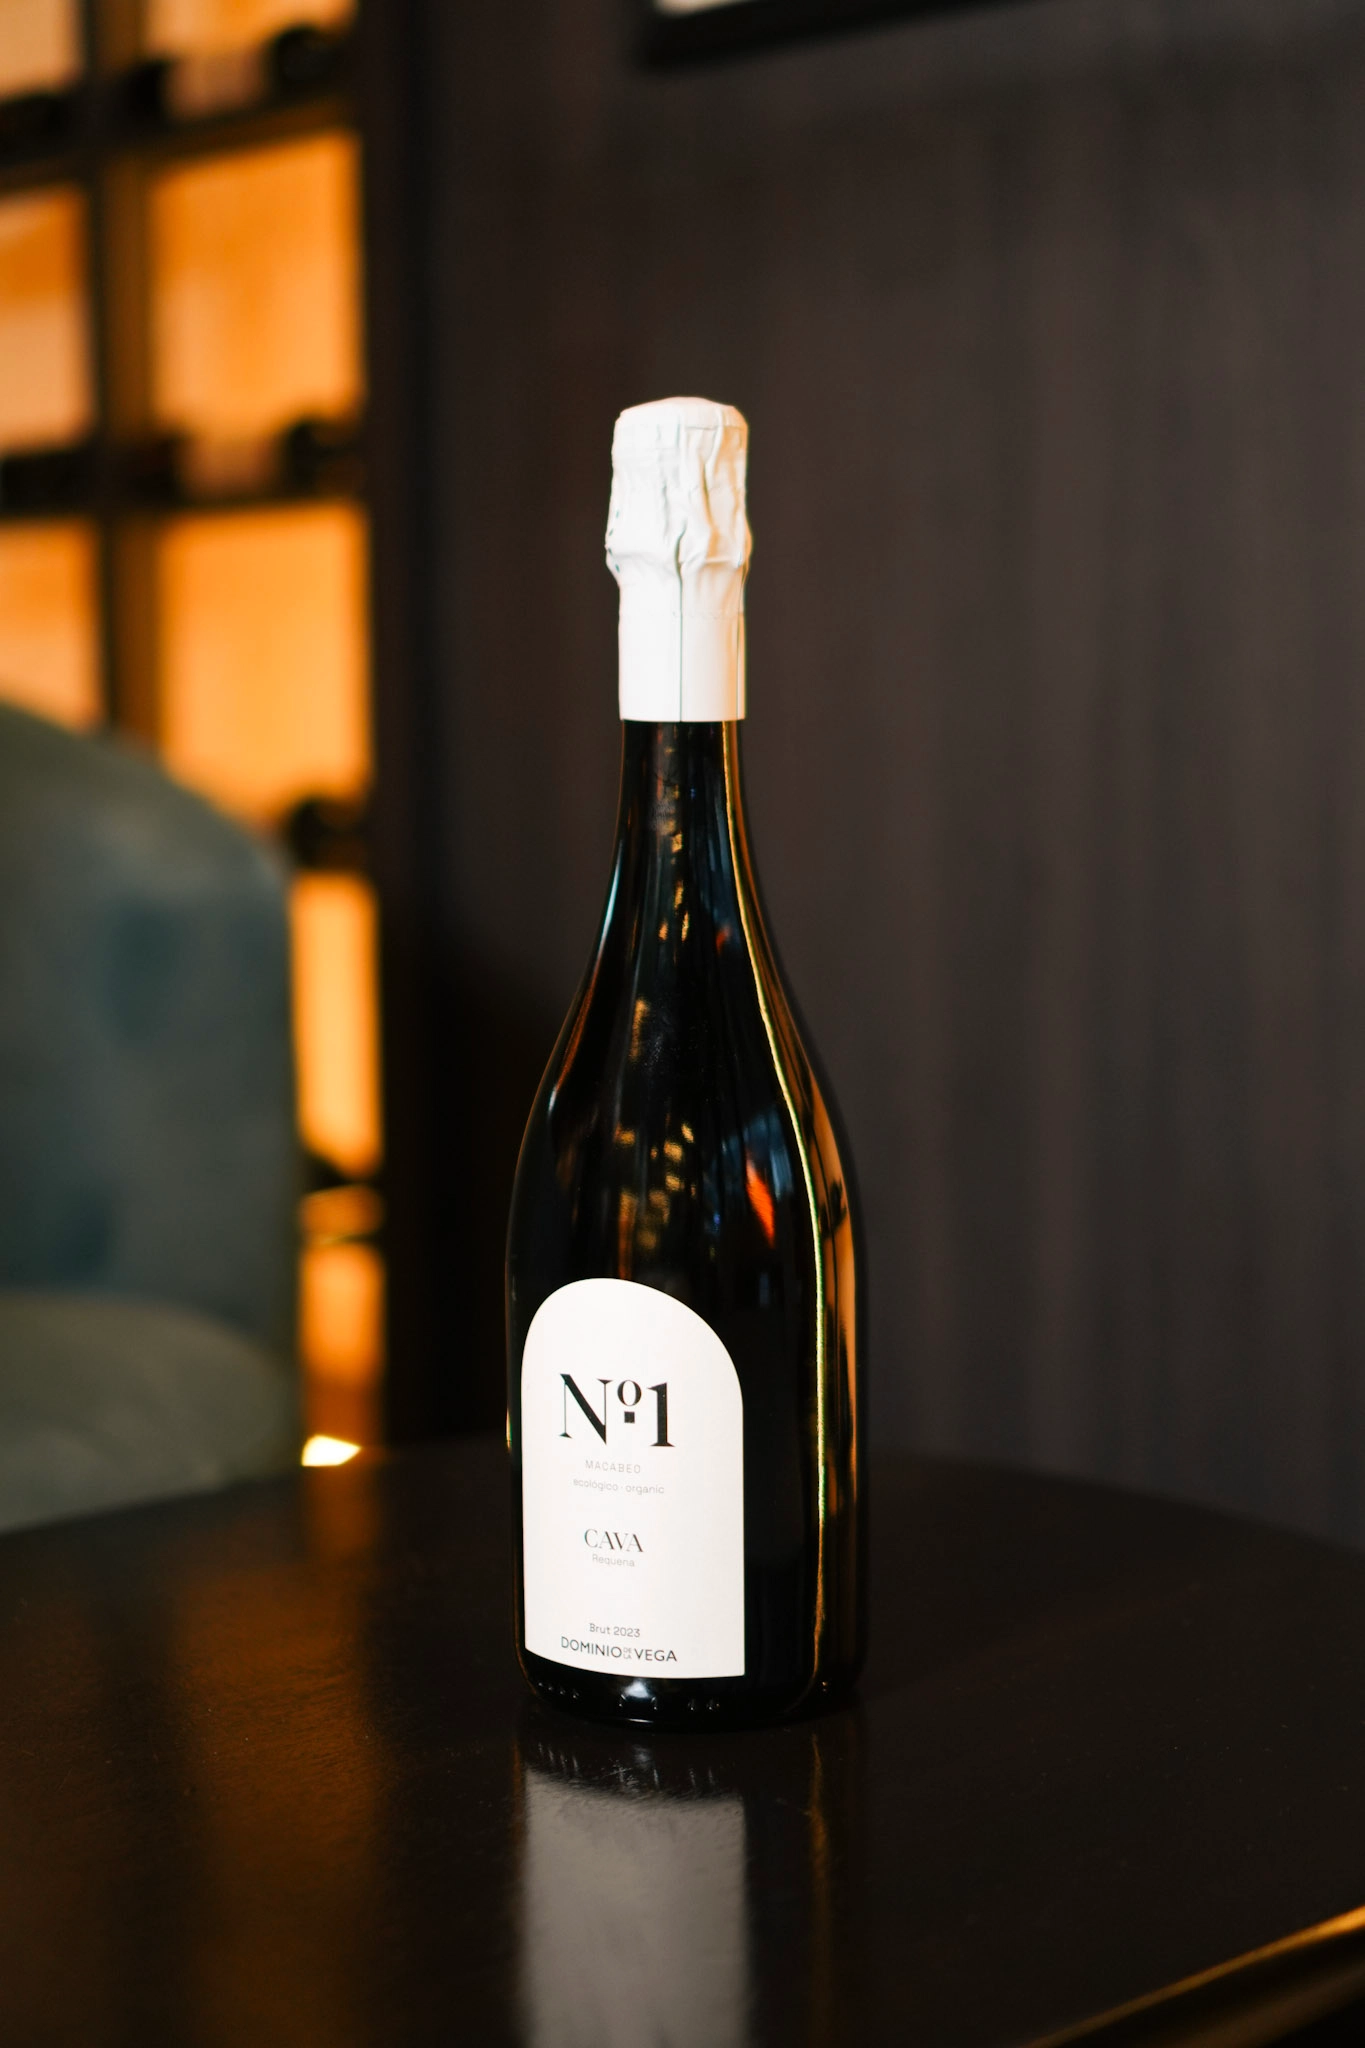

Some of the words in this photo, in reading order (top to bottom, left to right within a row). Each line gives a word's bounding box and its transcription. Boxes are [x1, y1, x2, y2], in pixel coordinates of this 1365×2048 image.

[585, 1460, 641, 1474] MACABEO
[625, 1484, 665, 1495] organic
[584, 1528, 644, 1553] CAVA
[592, 1553, 635, 1568] Requena
[589, 1622, 611, 1635] Brut
[613, 1626, 641, 1638] 2023
[561, 1636, 622, 1658] DOMINIO
[634, 1648, 678, 1662] VEGA
